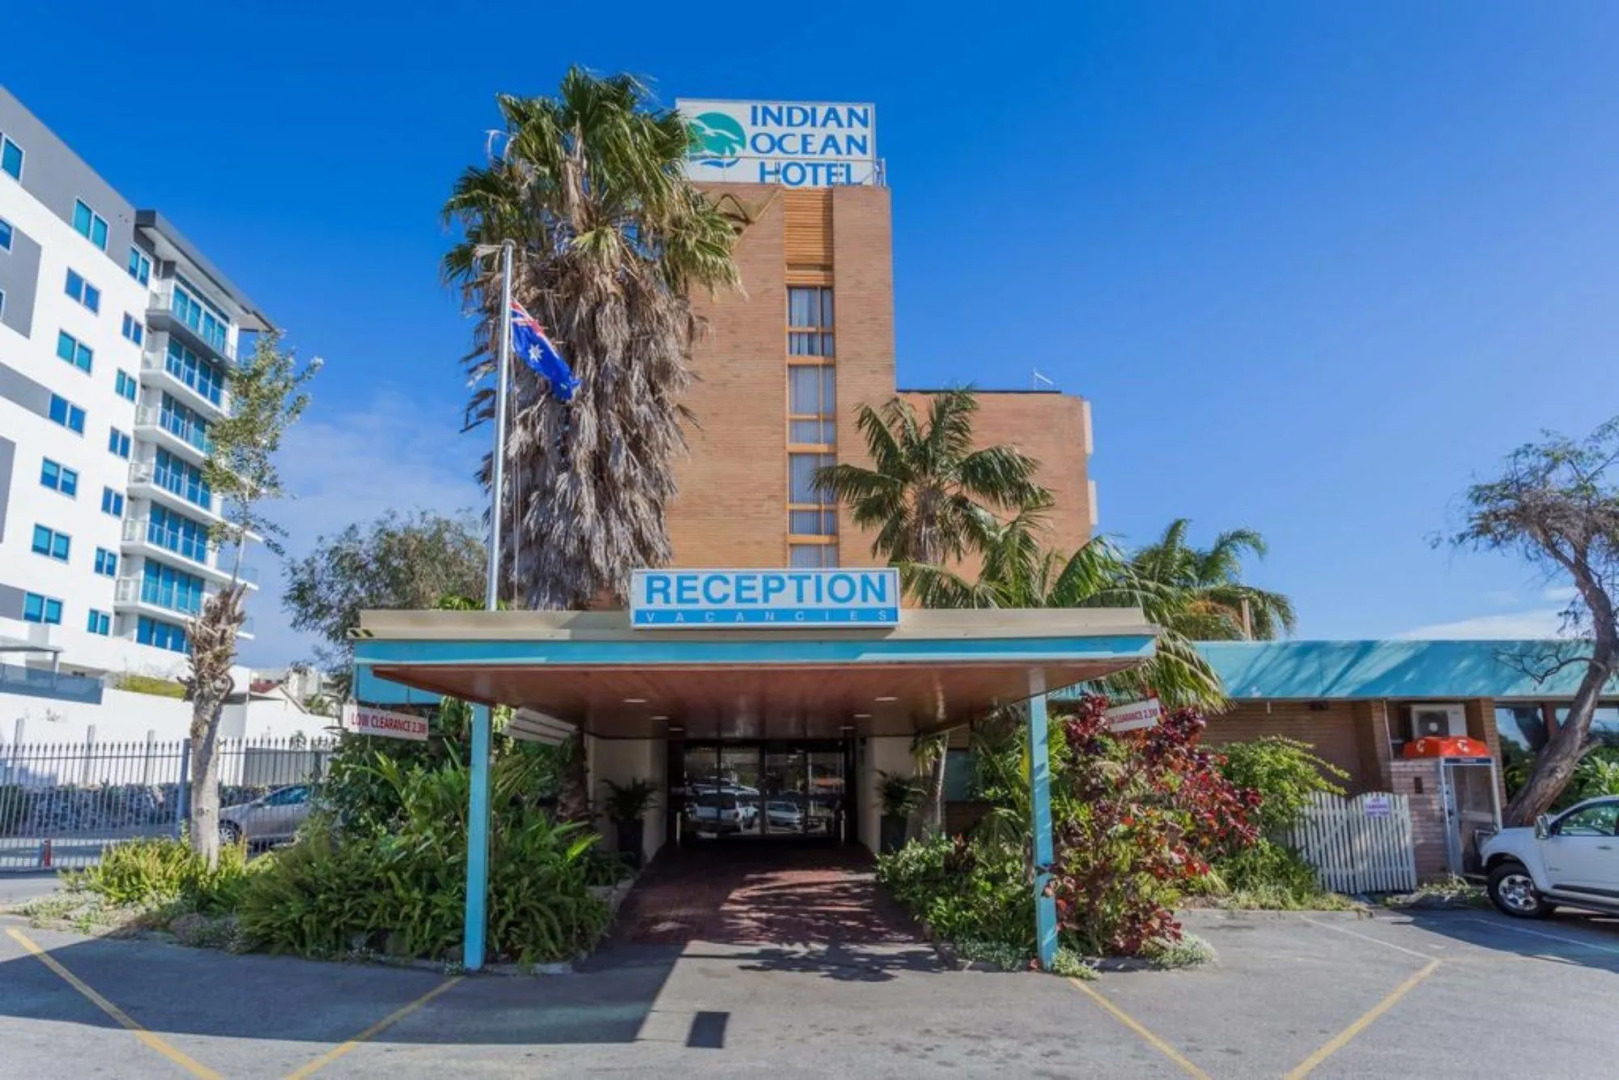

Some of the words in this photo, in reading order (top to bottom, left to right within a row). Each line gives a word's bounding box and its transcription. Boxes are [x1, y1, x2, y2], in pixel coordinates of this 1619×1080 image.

[750, 104, 869, 129] INDIAN
[750, 132, 868, 155] OCEAN
[759, 161, 864, 187] HOTEL
[645, 573, 887, 604] RECEPTION
[646, 610, 888, 622] VACANCIES
[351, 711, 370, 728] LOW
[371, 714, 410, 733] CLEARANCE
